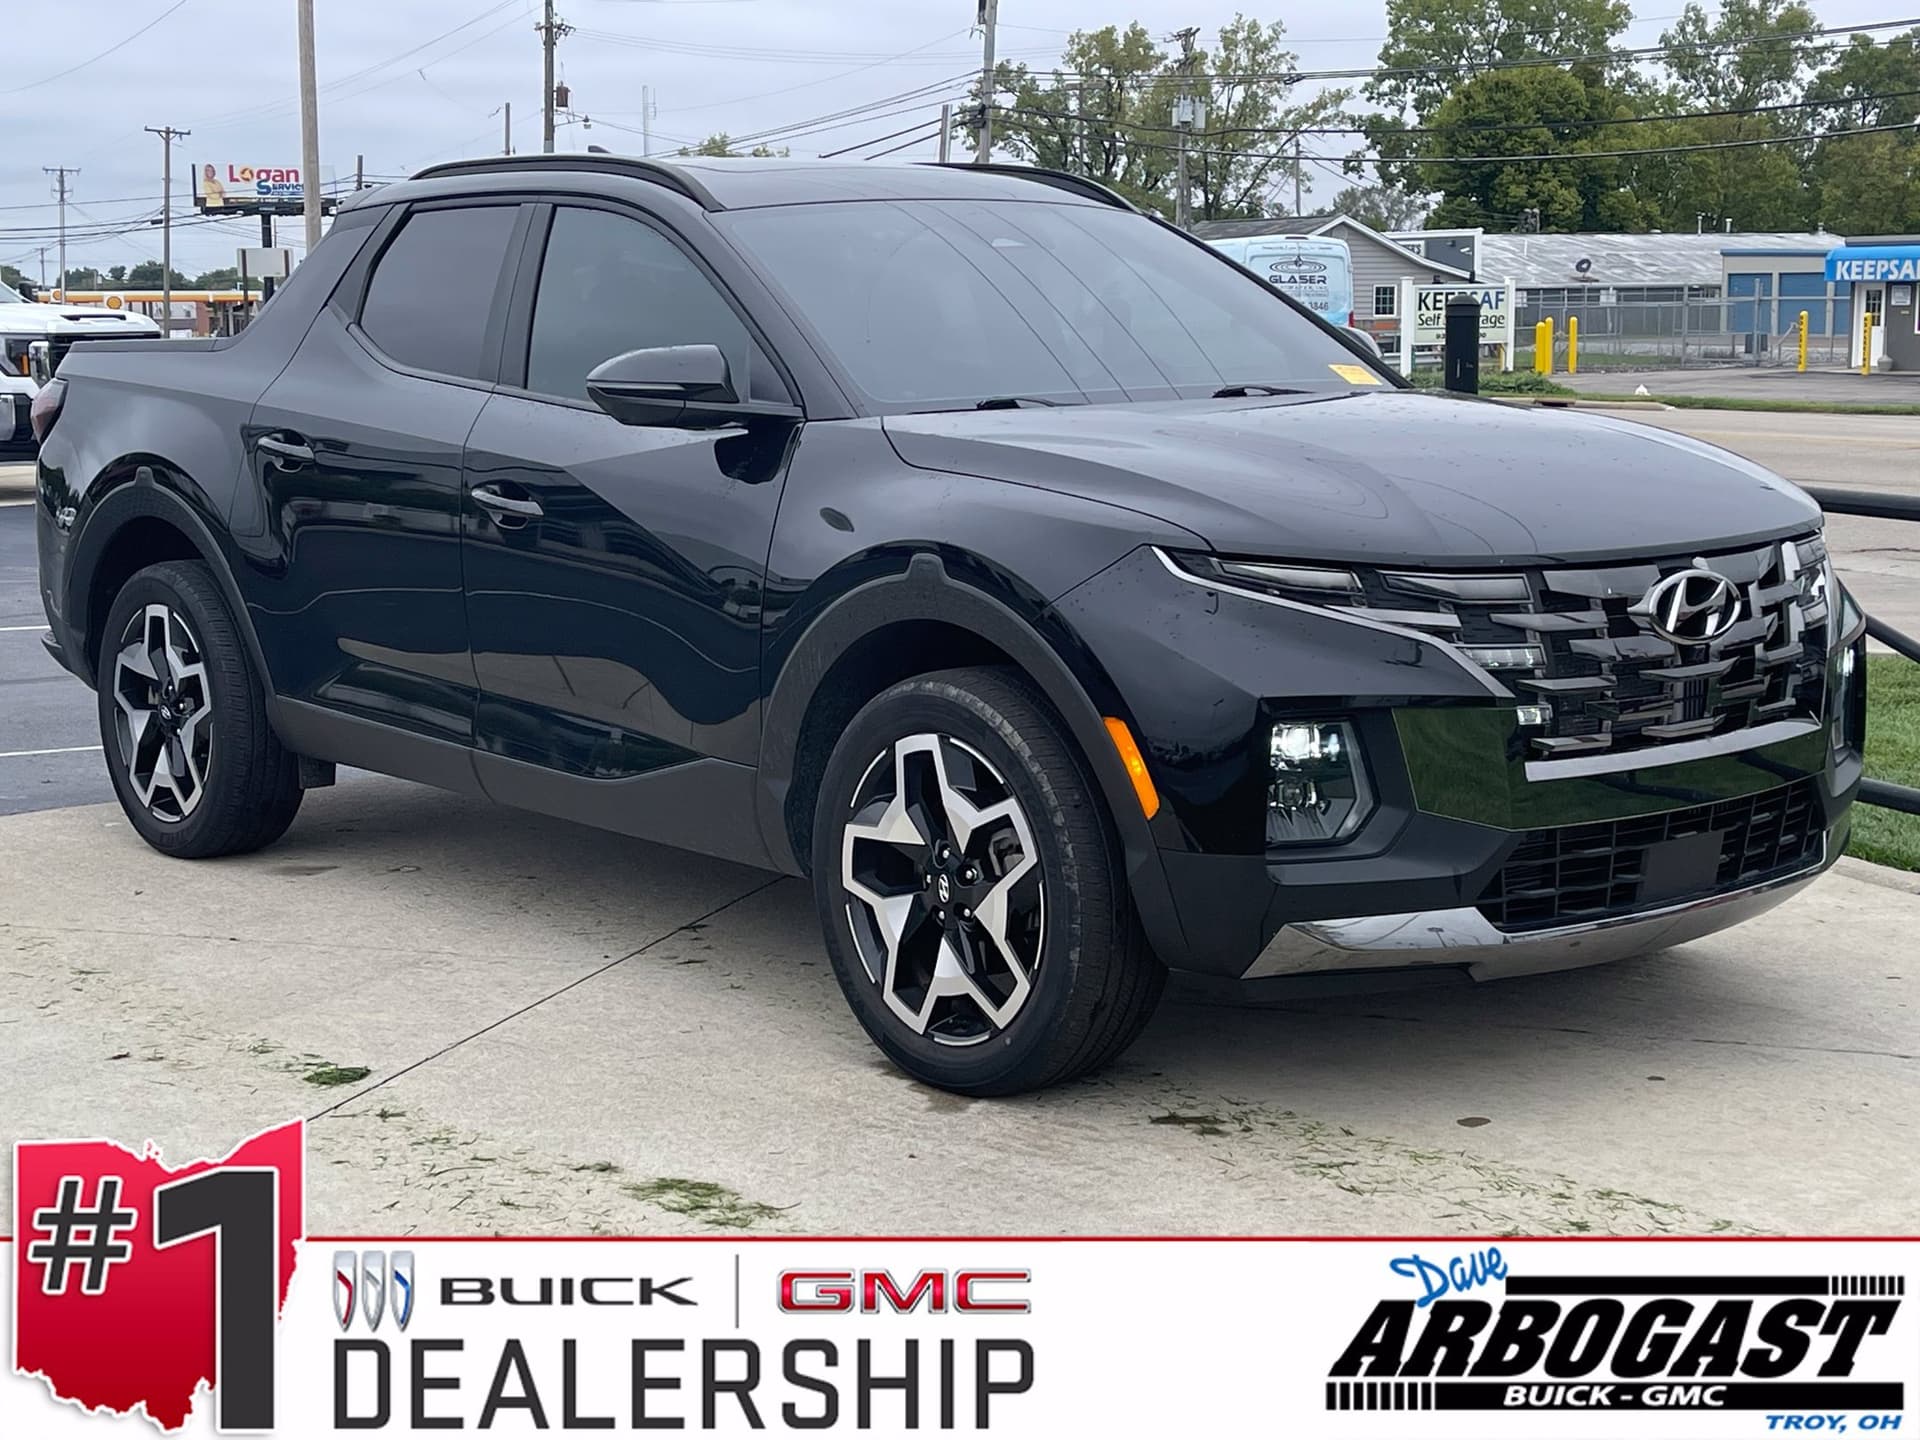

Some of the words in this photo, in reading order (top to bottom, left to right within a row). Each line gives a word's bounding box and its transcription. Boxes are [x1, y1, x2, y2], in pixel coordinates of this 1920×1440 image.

[228, 164, 299, 184] Logan
[1269, 275, 1327, 285] GLASER
[1418, 291, 1505, 311] KEEAF
[1418, 313, 1441, 326] Self
